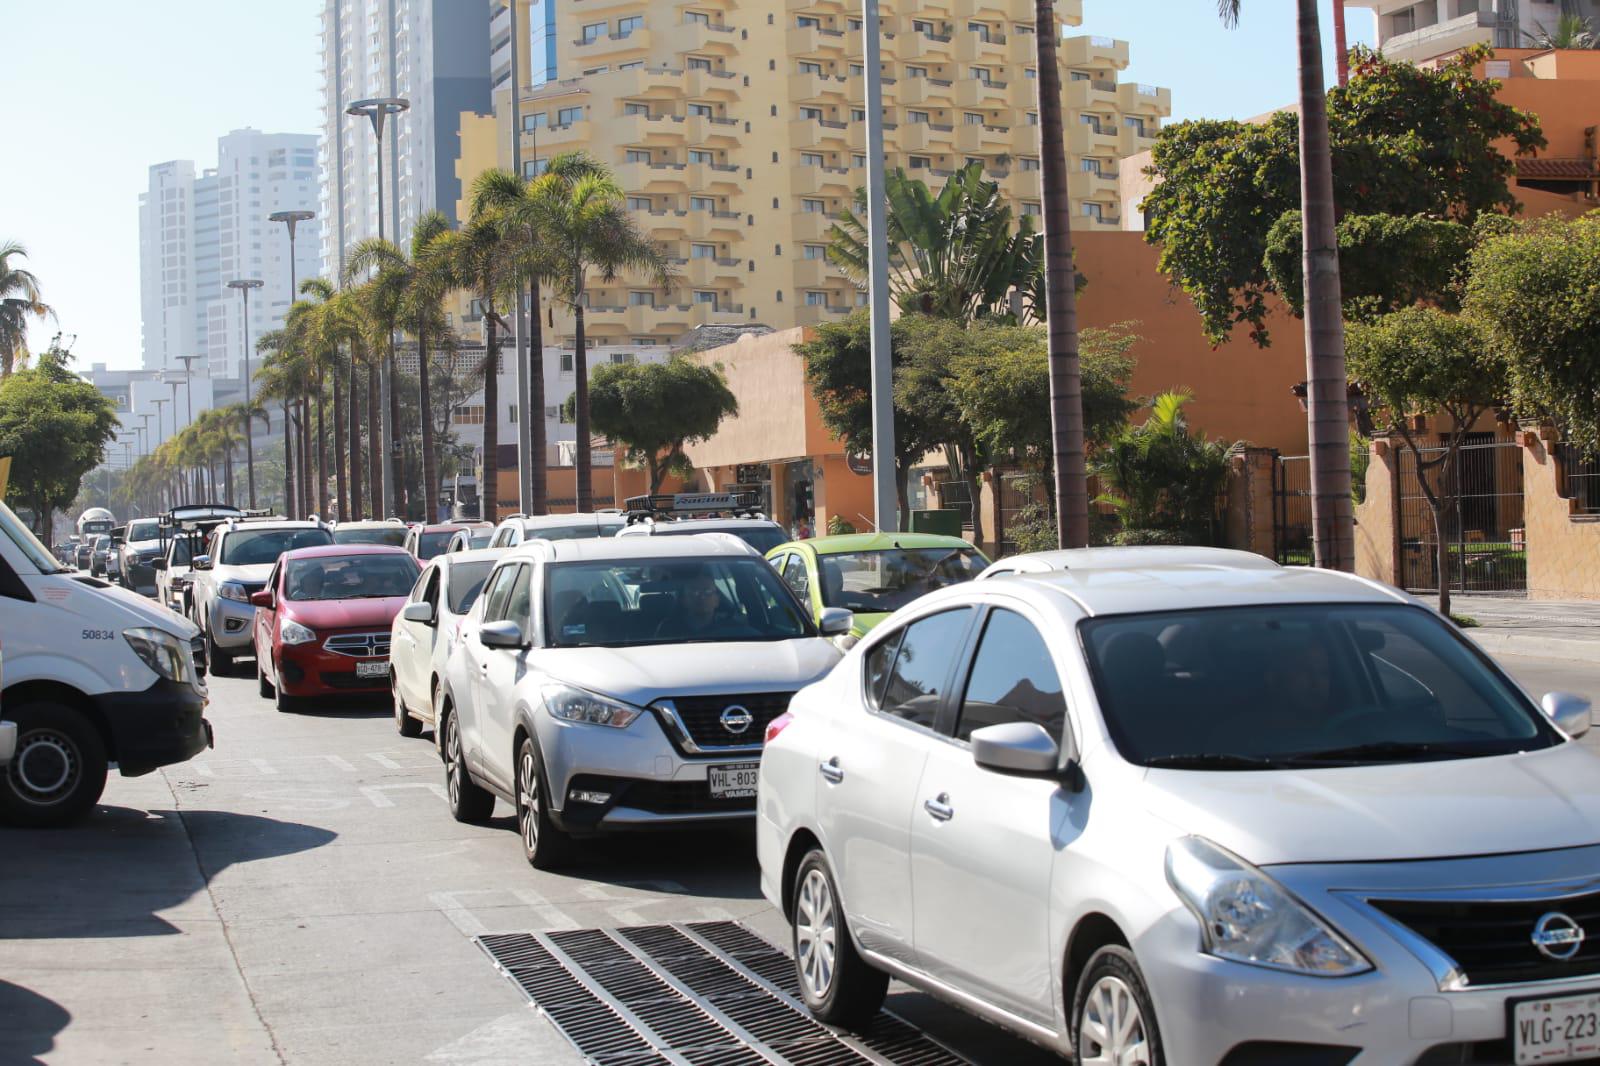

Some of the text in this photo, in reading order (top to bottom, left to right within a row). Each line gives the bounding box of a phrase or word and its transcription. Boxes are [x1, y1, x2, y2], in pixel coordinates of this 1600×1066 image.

[82, 629, 114, 640] 50834
[711, 771, 757, 787] VHL-803
[724, 788, 756, 798] VAMSA
[1519, 1011, 1597, 1046] VLG-223
